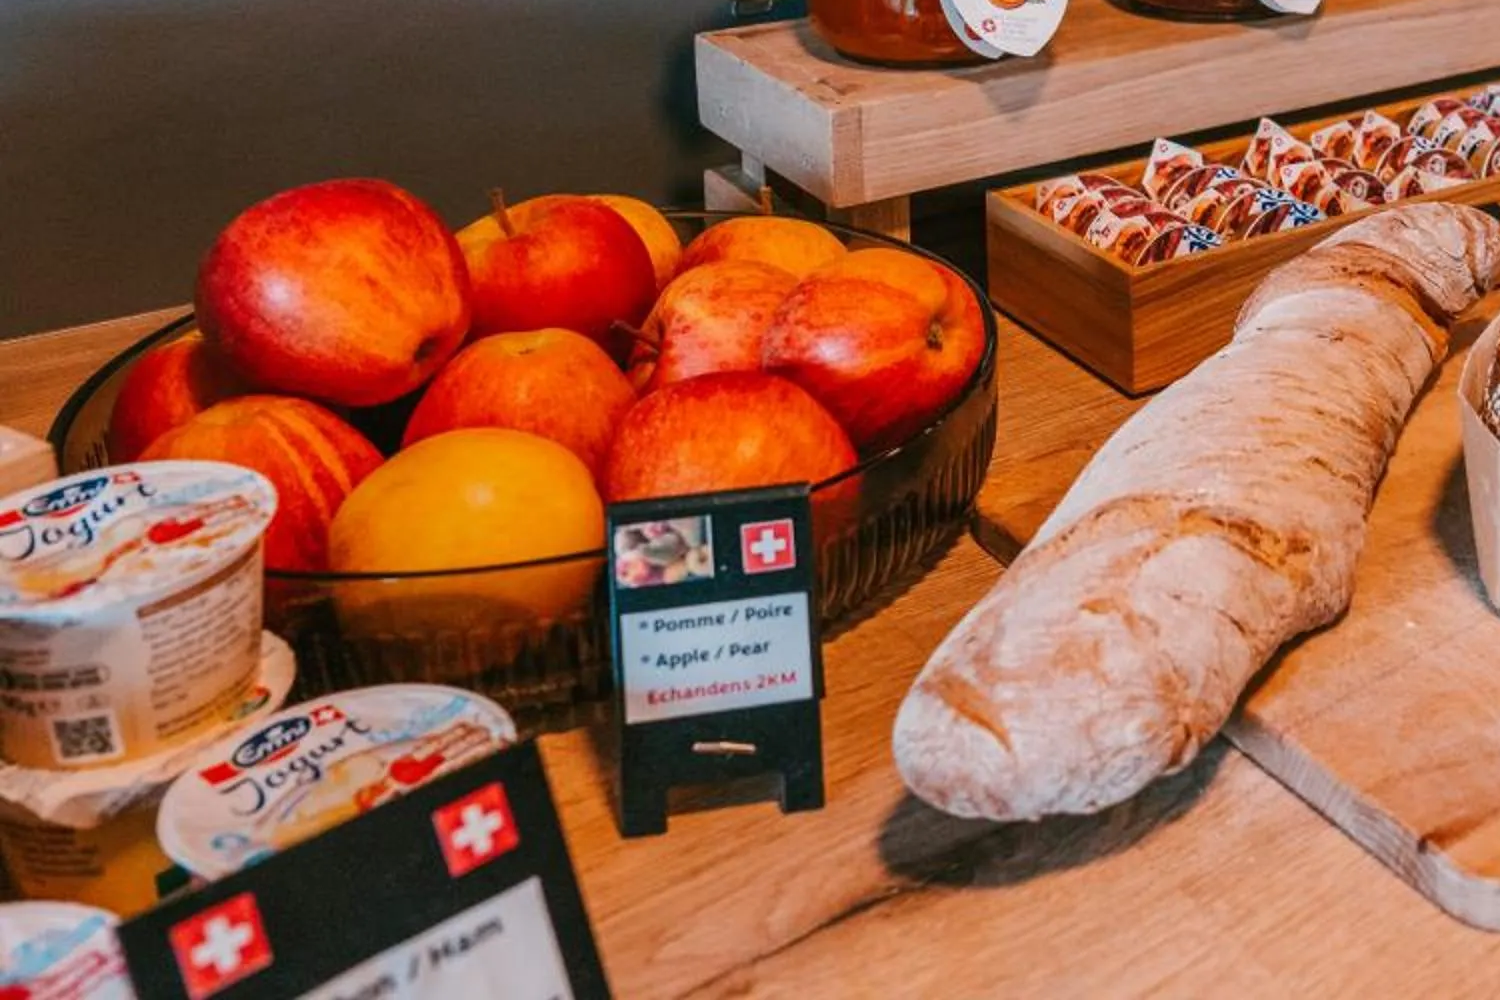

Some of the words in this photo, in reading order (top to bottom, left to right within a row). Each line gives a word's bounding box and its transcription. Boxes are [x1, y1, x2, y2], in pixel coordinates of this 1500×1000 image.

[0, 482, 157, 562] Jogurt
[653, 613, 726, 633] Pomme
[744, 602, 794, 622] Poire
[655, 648, 711, 671] Apple
[728, 640, 771, 657] Pear
[646, 678, 752, 705] Echandens
[756, 671, 798, 690] 2KM
[218, 717, 373, 817] Jogurt
